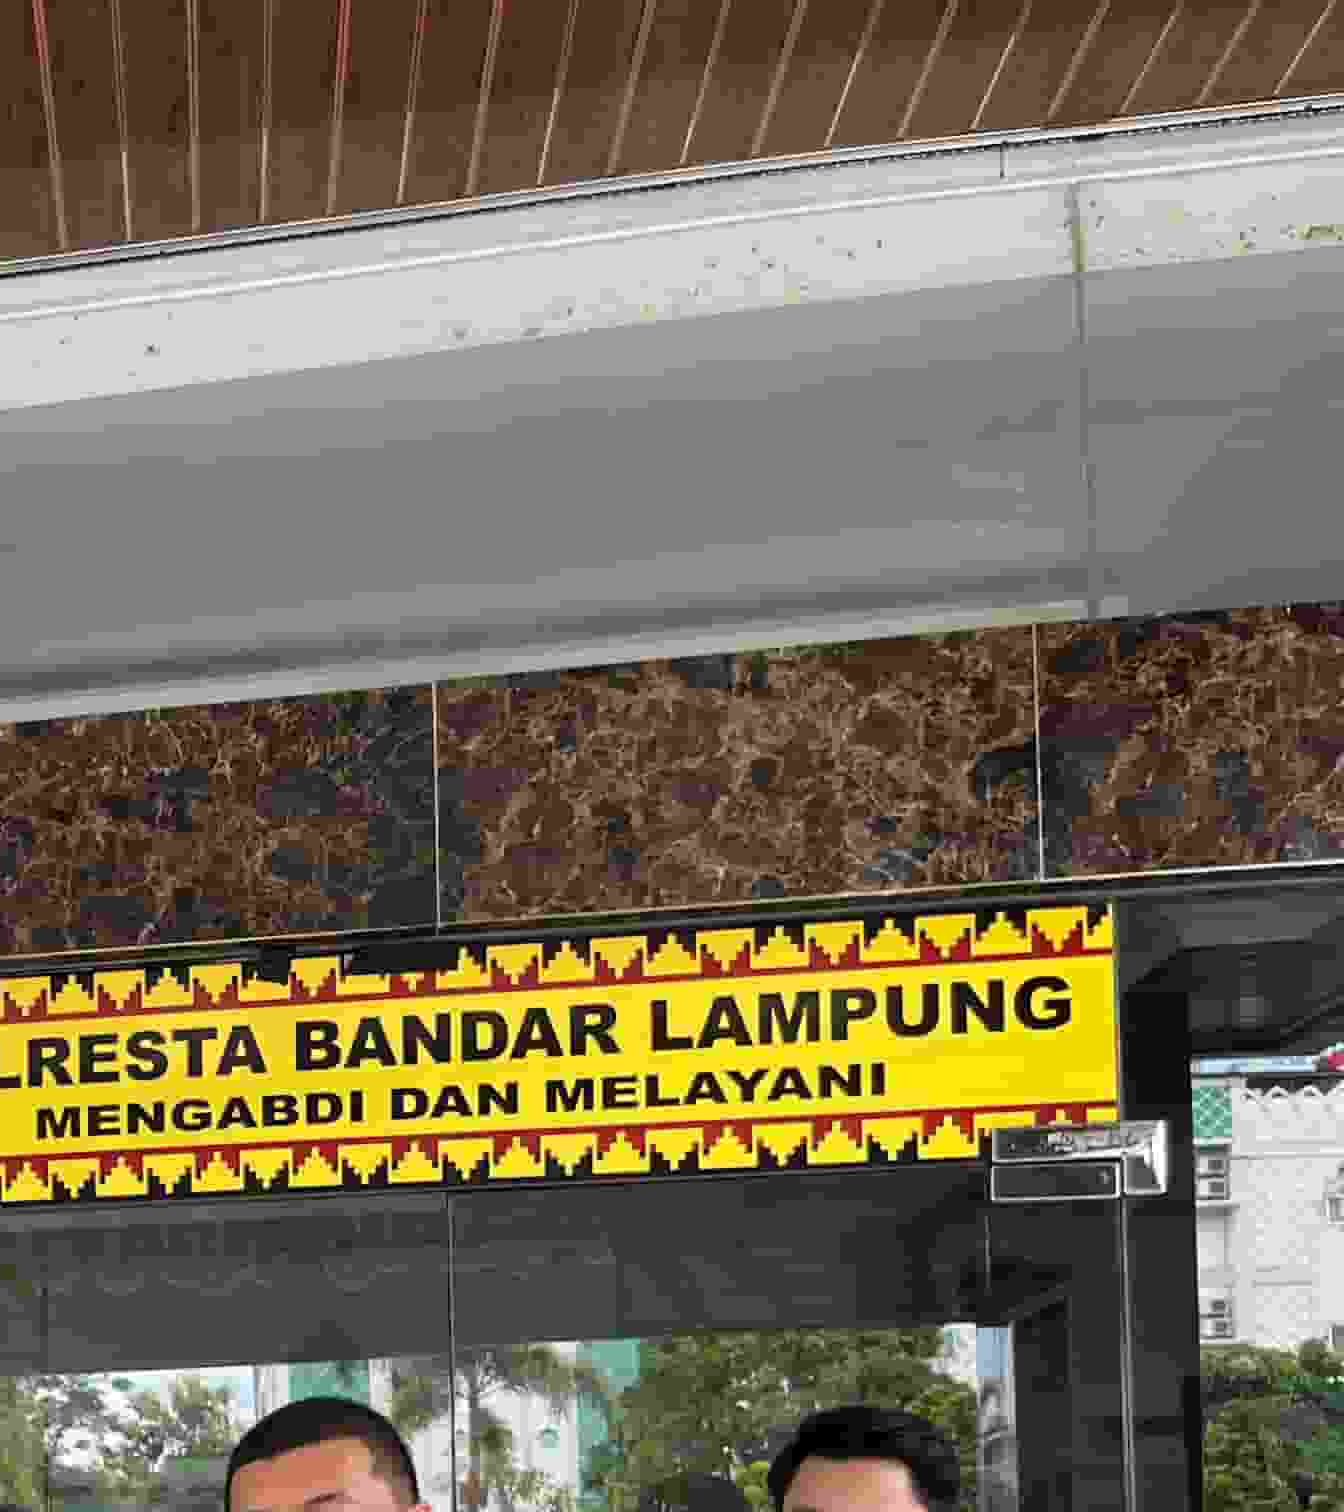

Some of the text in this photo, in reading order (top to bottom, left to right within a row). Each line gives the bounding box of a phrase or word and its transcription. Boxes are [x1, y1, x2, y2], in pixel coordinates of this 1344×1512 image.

[295, 1002, 621, 1072] BANDAR
[649, 975, 1073, 1053] LAMPUNG
[34, 1061, 886, 1139] MENGABDI DAN MELAYANI
